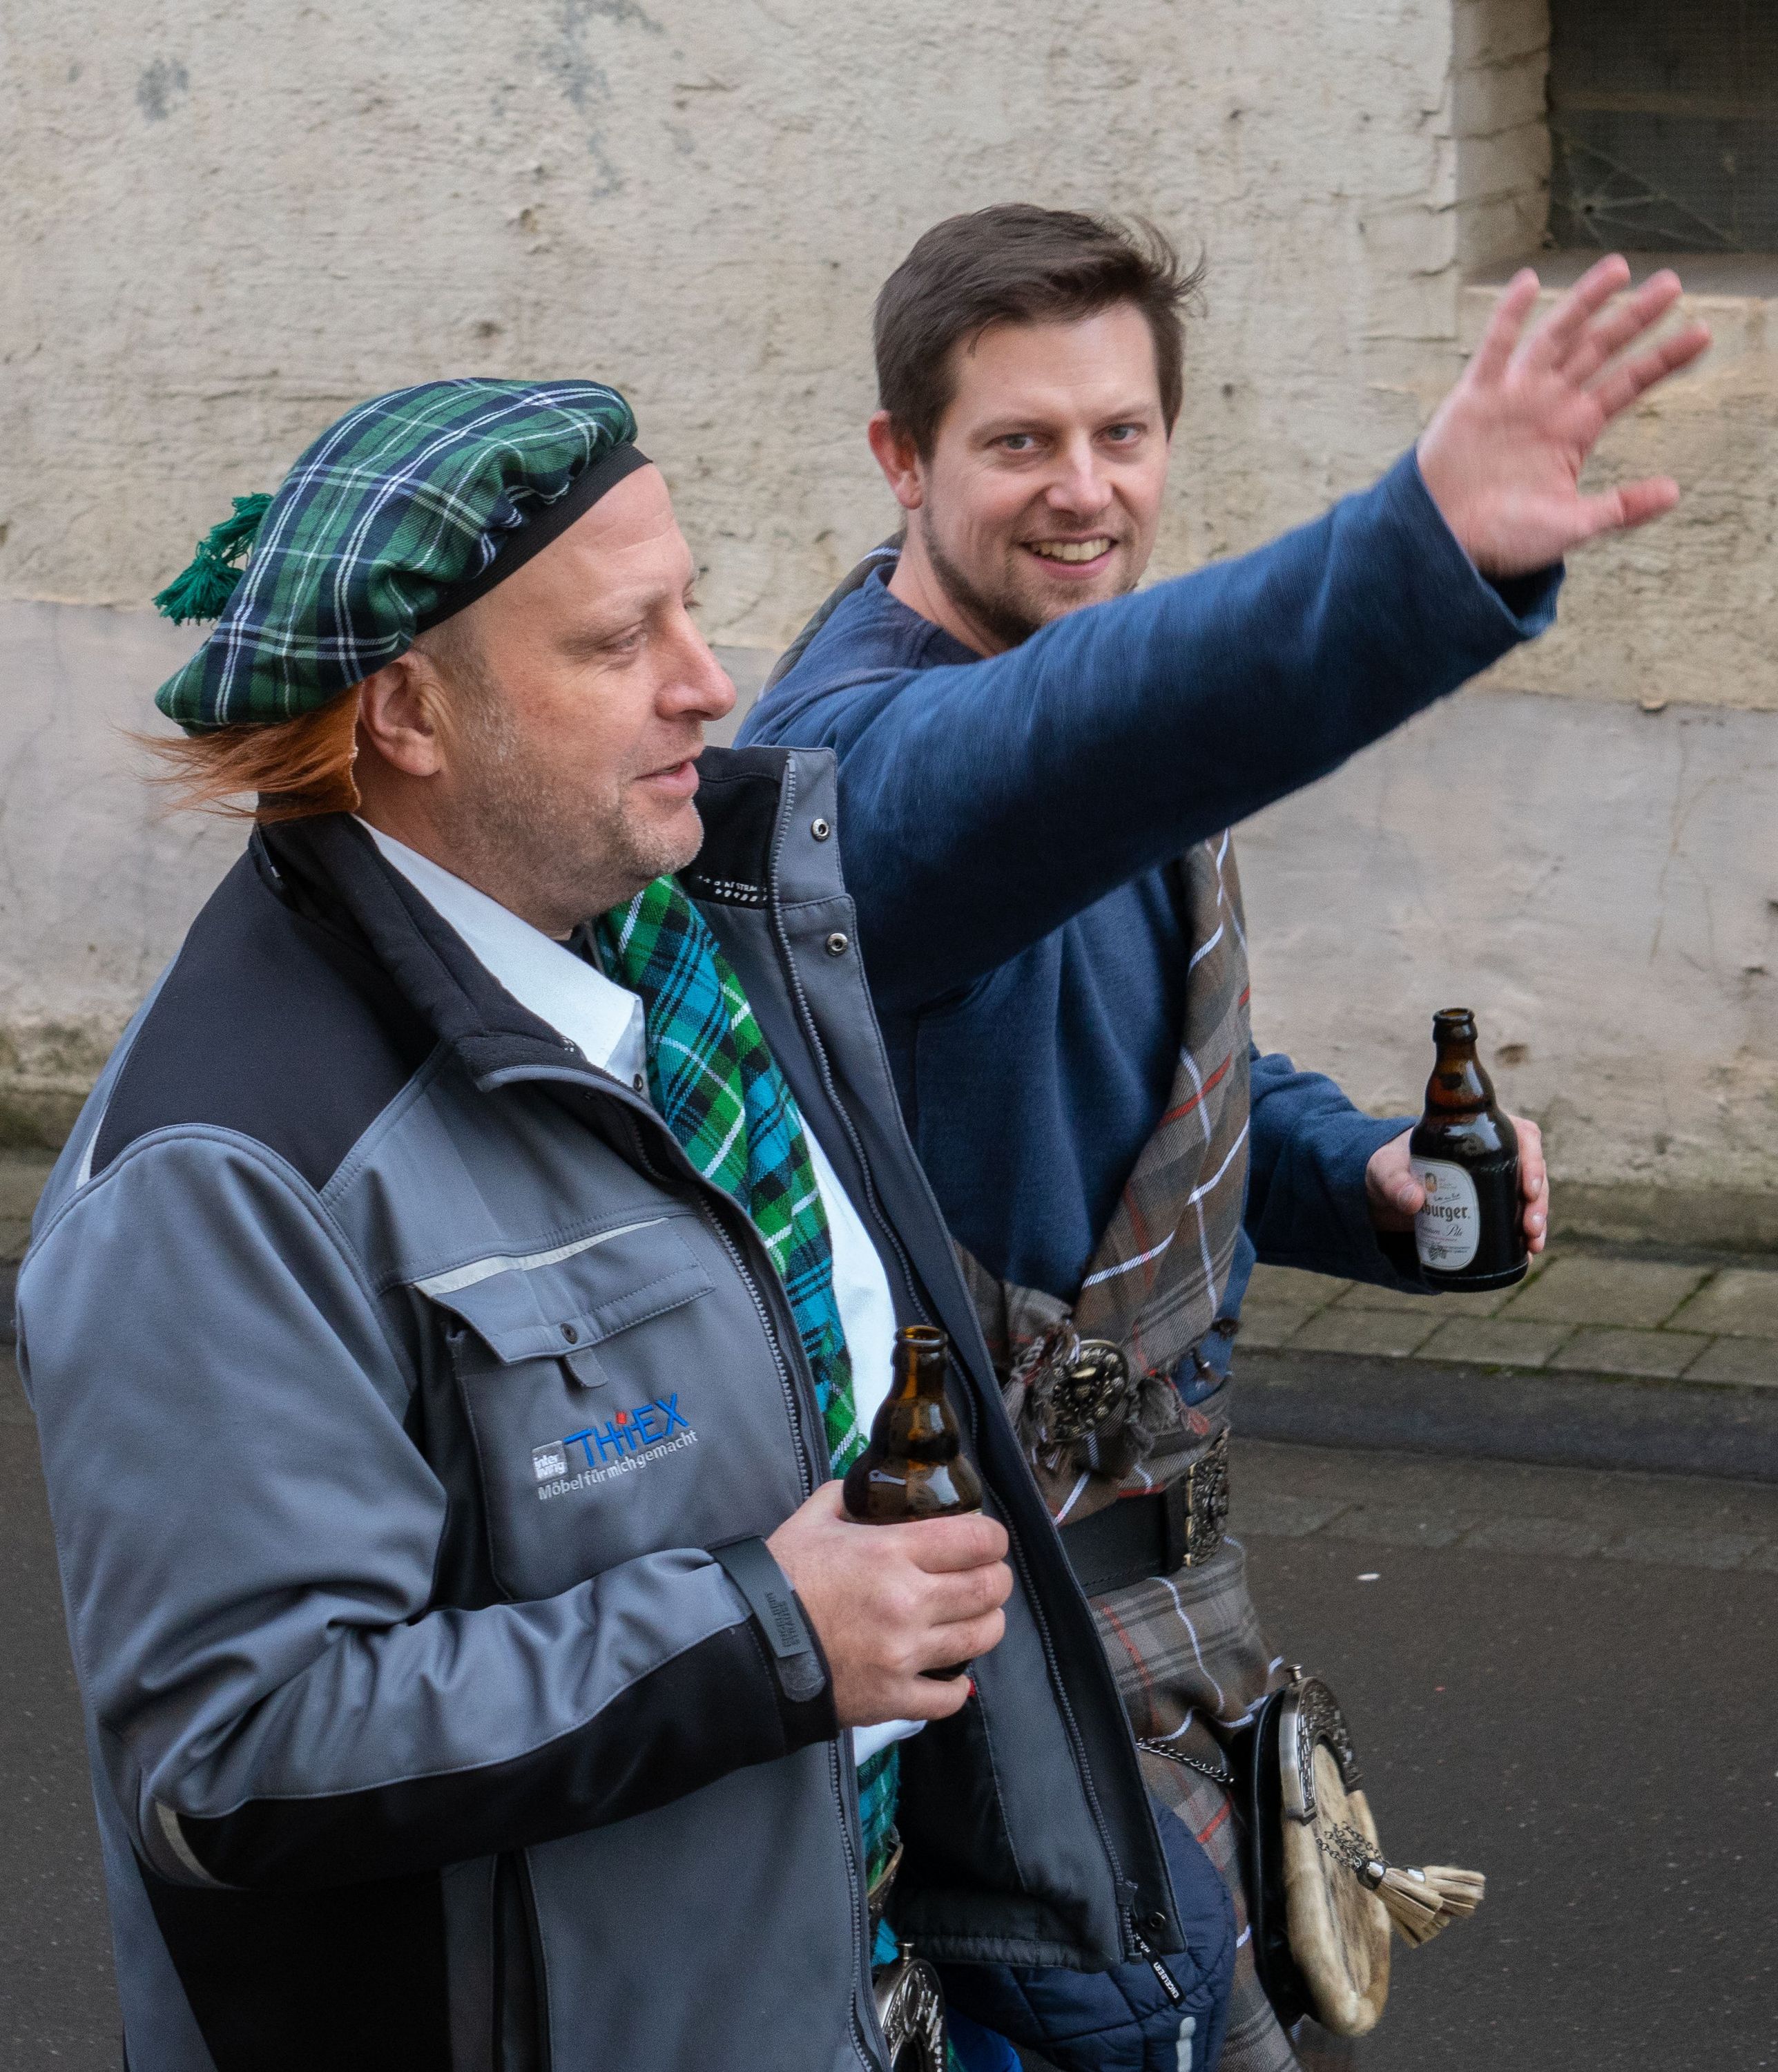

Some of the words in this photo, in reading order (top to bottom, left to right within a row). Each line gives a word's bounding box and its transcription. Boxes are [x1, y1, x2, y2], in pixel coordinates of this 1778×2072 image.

[537, 1473, 584, 1500] Möbel
[583, 1468, 606, 1486] für
[607, 1456, 637, 1479] mich
[636, 1430, 698, 1468] gemacht
